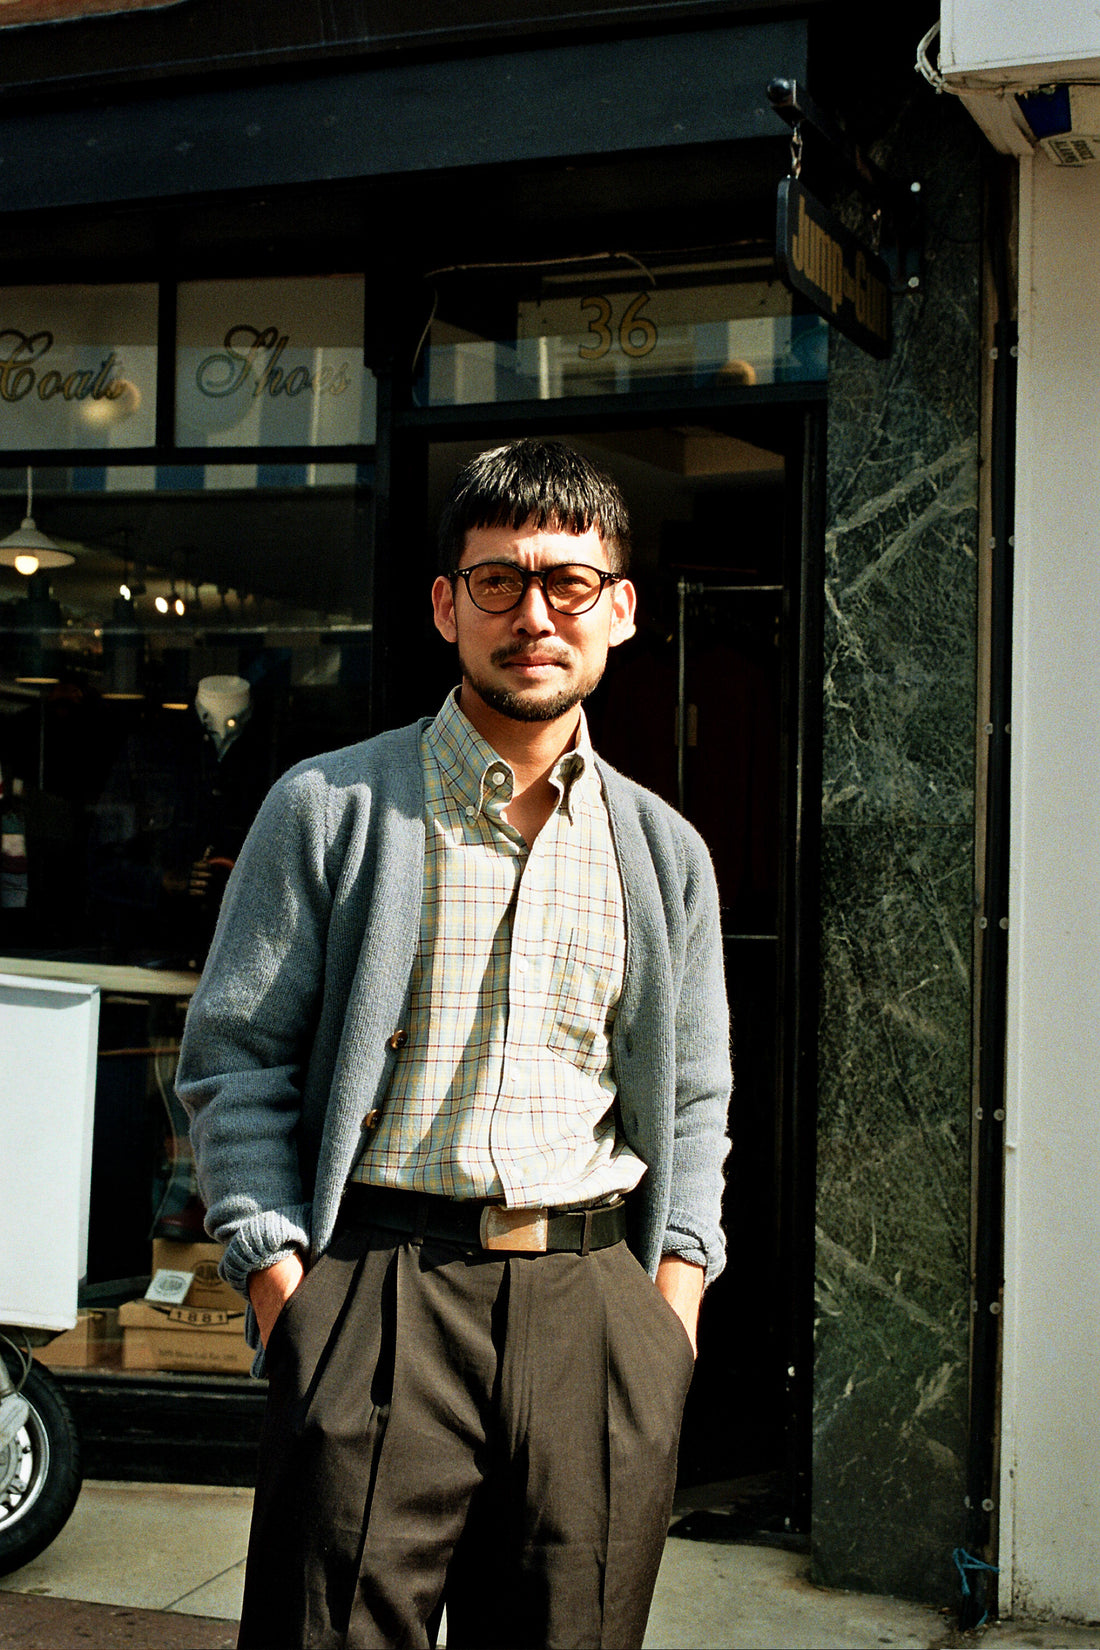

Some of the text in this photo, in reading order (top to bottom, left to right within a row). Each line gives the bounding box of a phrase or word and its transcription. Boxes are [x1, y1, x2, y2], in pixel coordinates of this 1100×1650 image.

[196, 324, 350, 398] Shoes
[578, 292, 658, 361] 36
[0, 329, 127, 401] Coats
[177, 1311, 223, 1323] 1881
